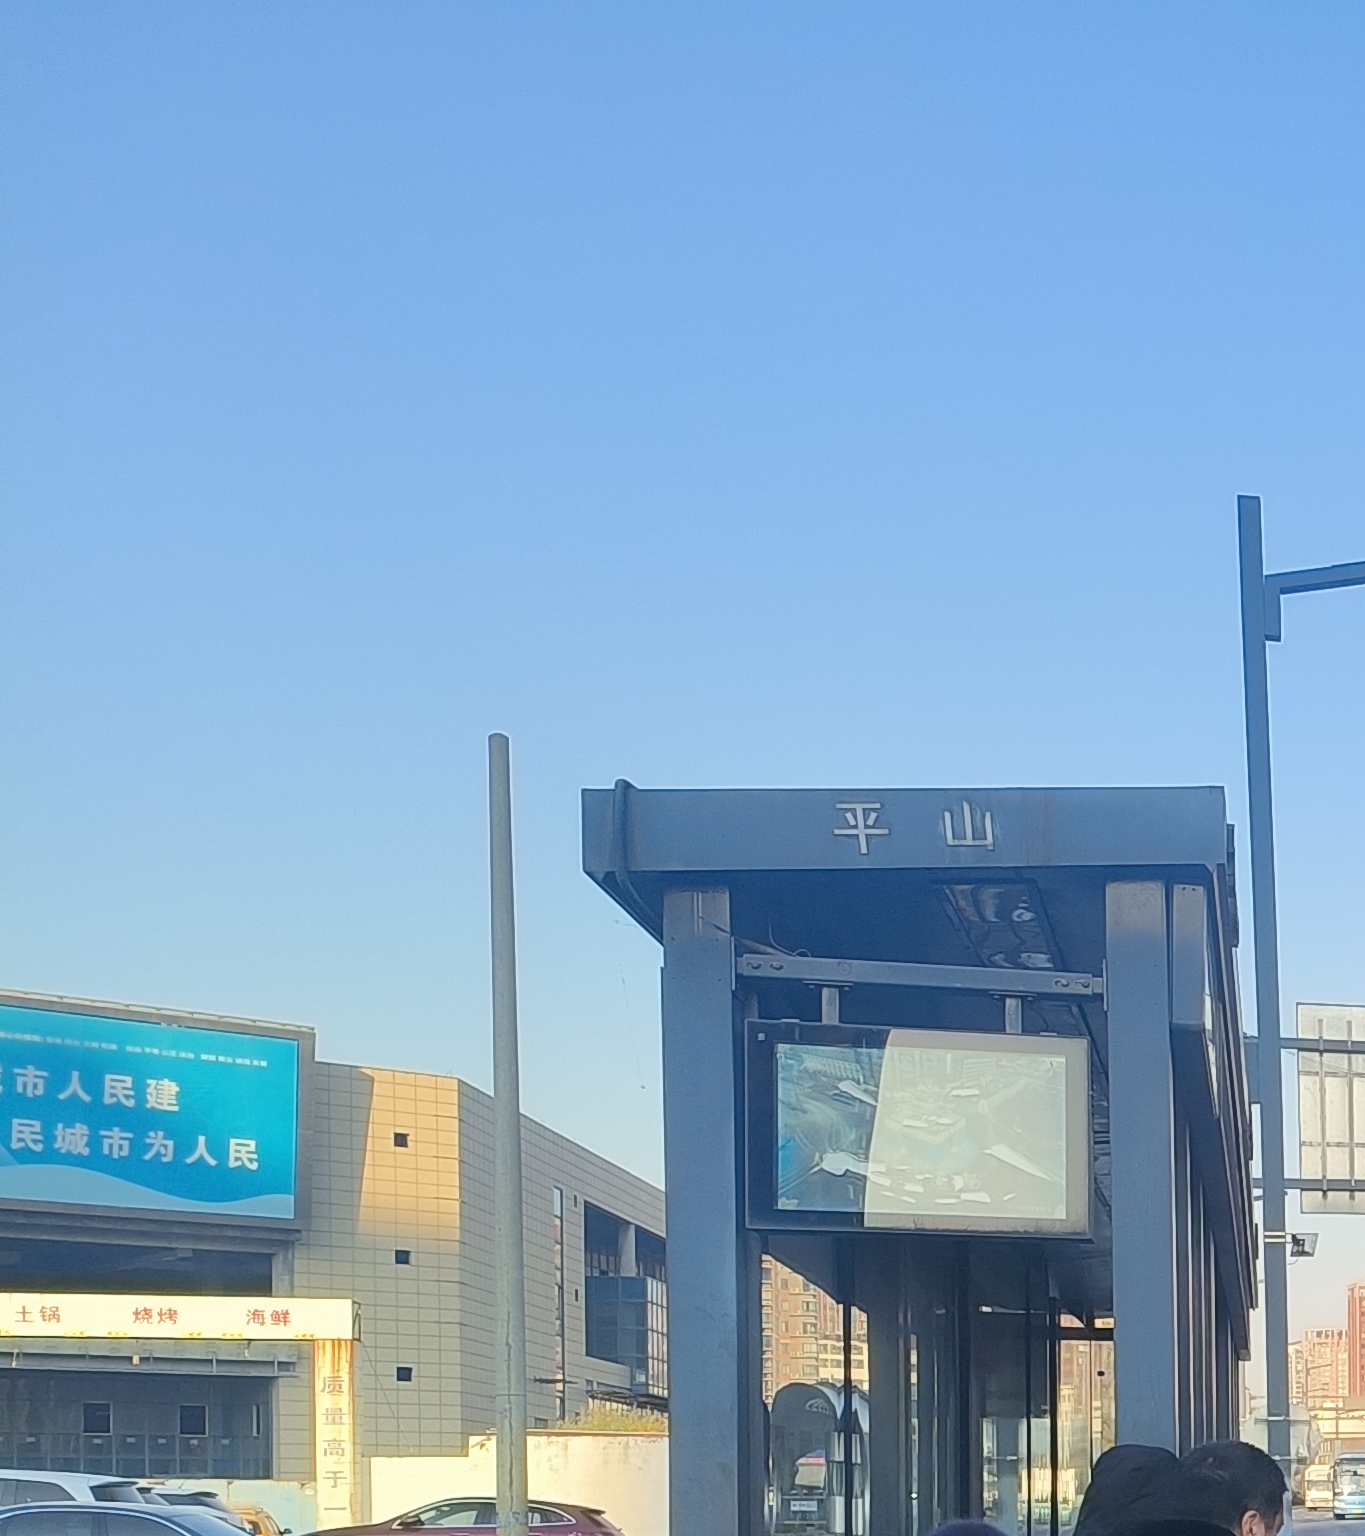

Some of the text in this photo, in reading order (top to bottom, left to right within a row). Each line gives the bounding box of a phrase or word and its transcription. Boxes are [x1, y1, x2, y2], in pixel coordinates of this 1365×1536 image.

[832, 800, 996, 856] 平山
[0, 1062, 181, 1112] 市人民建
[10, 1117, 260, 1171] 民城市为人民
[14, 1305, 292, 1328] 土锅 烧烤 海鲜
